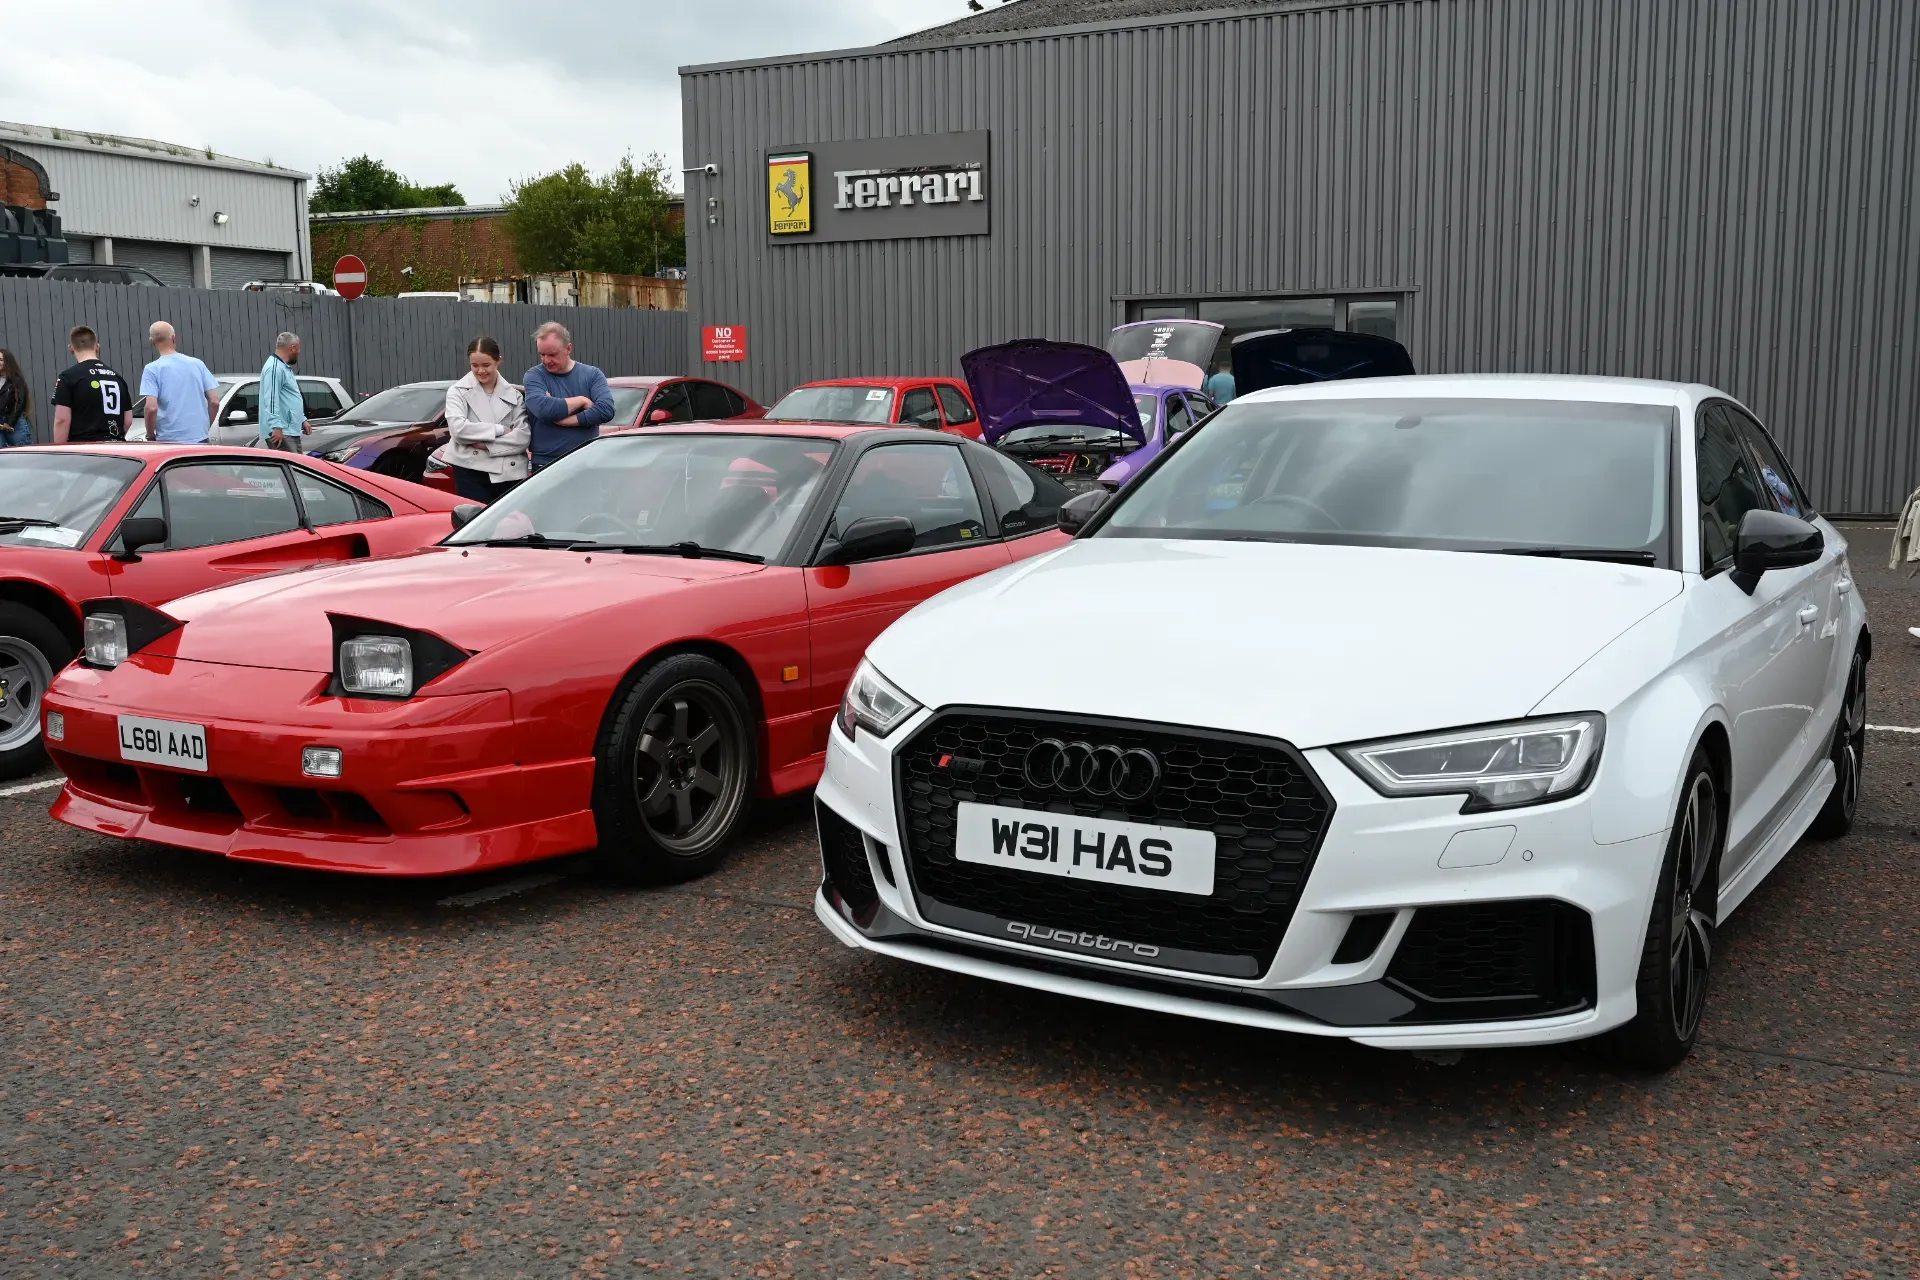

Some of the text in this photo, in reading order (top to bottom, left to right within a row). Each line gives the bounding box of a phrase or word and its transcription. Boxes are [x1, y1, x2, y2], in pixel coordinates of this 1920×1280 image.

[833, 161, 984, 210] Ferrari
[773, 219, 807, 231] Ferrari
[716, 327, 732, 338] NO
[104, 384, 117, 411] 5
[871, 391, 881, 399] L
[120, 725, 204, 760] L681 AAD
[992, 818, 1173, 877] W31 HAS
[1006, 921, 1160, 958] quattro
